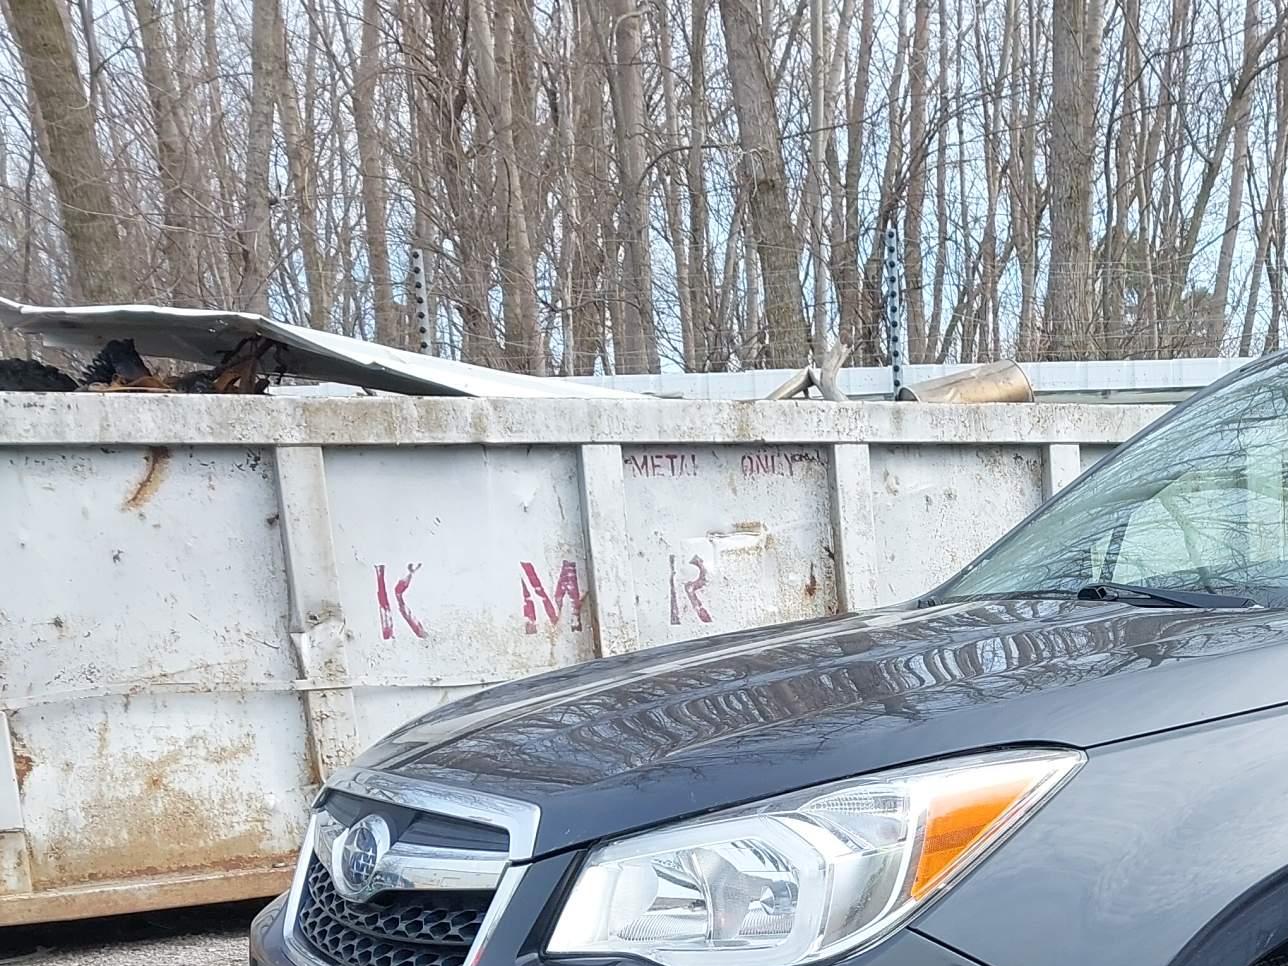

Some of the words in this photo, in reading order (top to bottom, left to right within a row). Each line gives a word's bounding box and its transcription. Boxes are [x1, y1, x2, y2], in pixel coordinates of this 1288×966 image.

[374, 562, 427, 640] K
[520, 559, 583, 635] M
[669, 554, 713, 625] R
